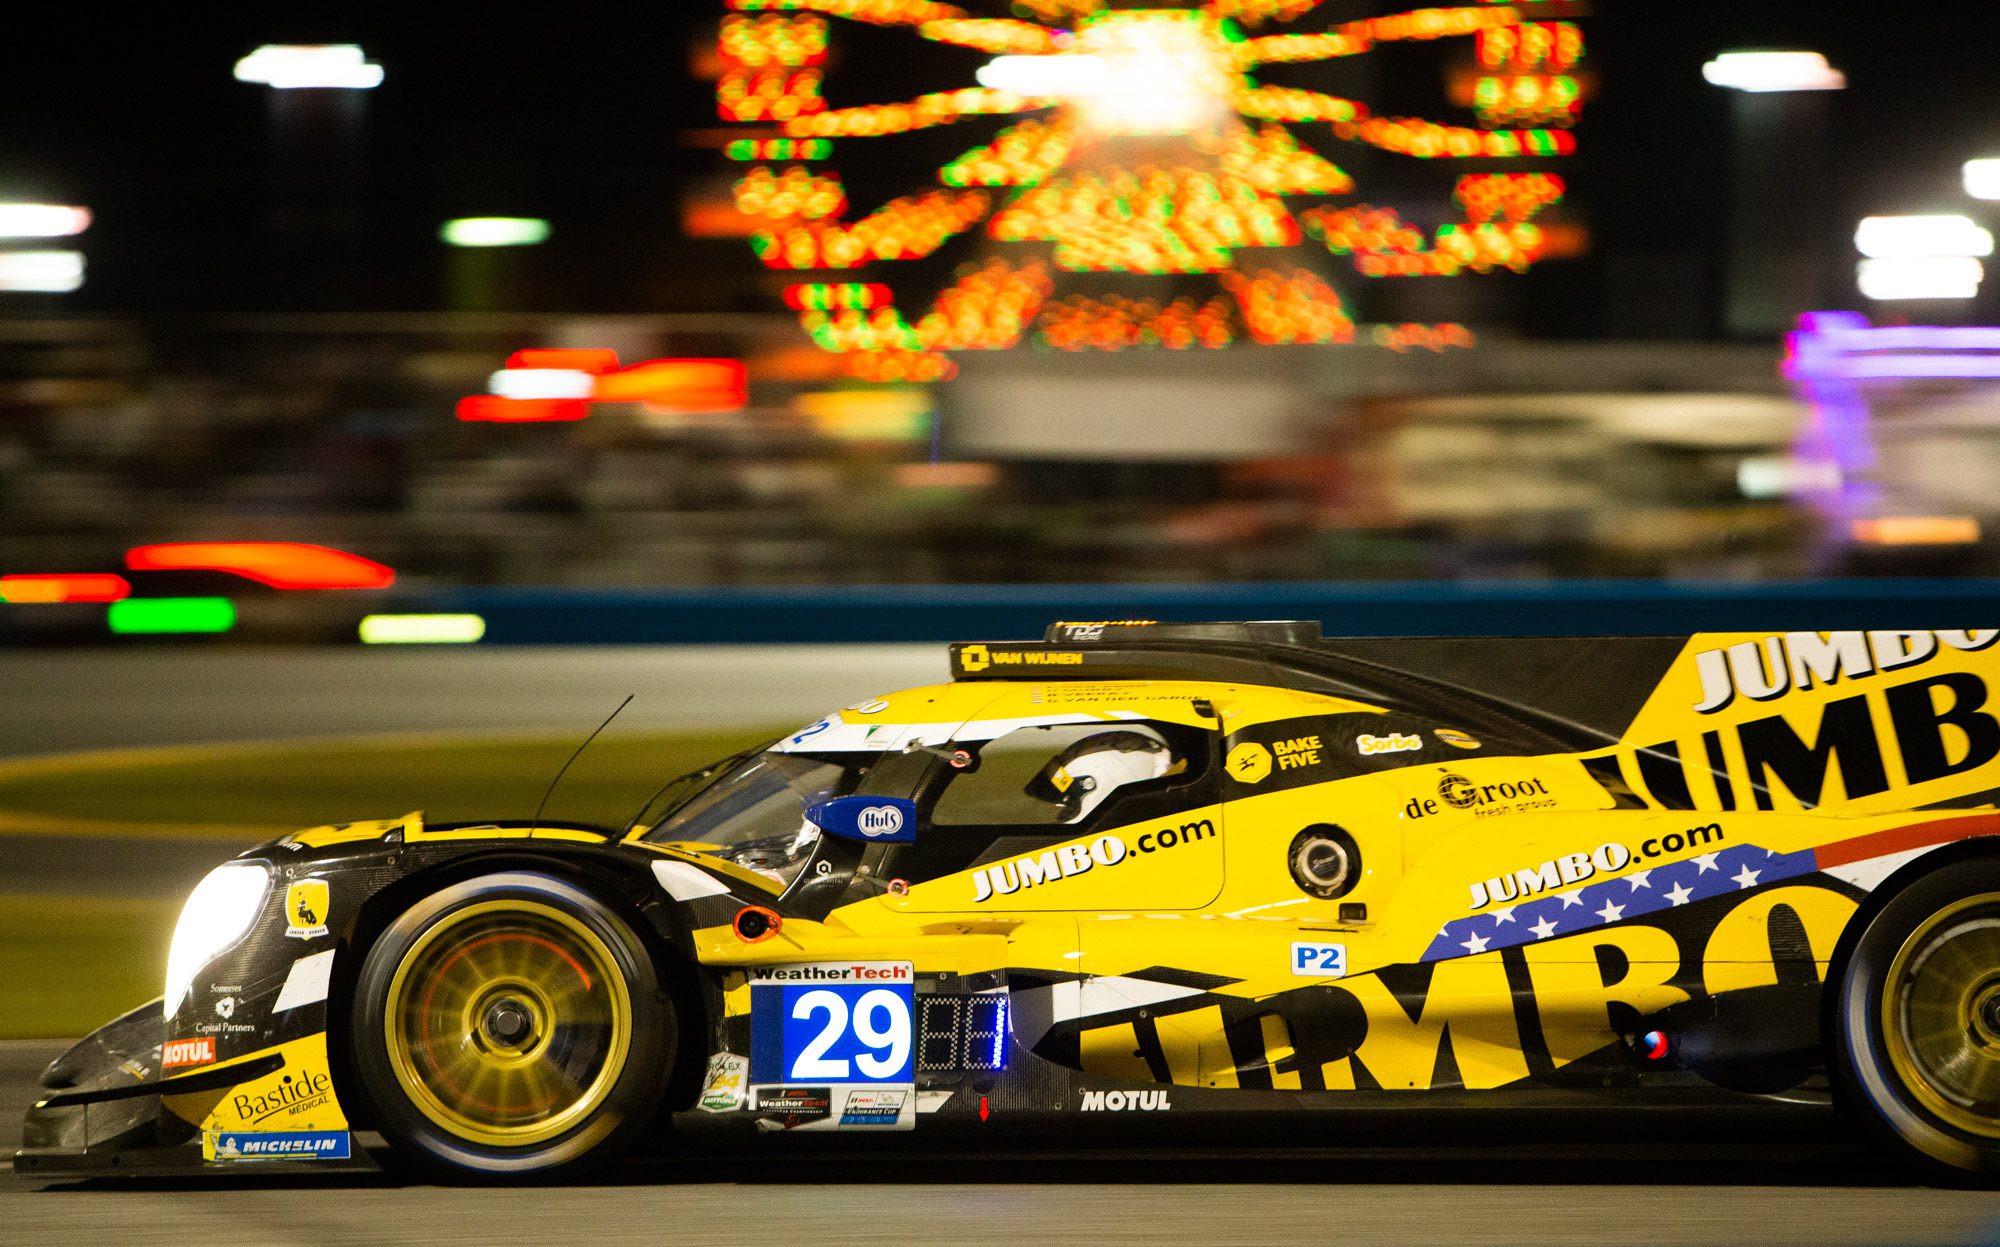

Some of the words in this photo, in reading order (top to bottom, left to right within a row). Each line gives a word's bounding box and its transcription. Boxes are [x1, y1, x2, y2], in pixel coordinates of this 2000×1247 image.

[1065, 625, 1105, 637] TDS
[991, 652, 1023, 664] VAN
[1273, 735, 1323, 755] BAKE
[1277, 750, 1321, 771] FIVE
[1406, 797, 1439, 820] de
[1440, 774, 1549, 809] Groot
[1475, 804, 1511, 818] fresh
[1515, 799, 1557, 813] group
[972, 819, 1216, 902] JUMBO.com
[1469, 822, 1724, 909] JUMBO.com
[1297, 946, 1340, 969] P2
[755, 965, 908, 980] WeatherTech
[210, 983, 242, 993] Somerset
[195, 1022, 221, 1035] Capital
[222, 1022, 255, 1032] Partners
[791, 989, 911, 1079] 29
[162, 1041, 213, 1065] MOTUL
[234, 1069, 330, 1120] Bastide
[1080, 1090, 1172, 1112] MOTUL
[243, 1138, 337, 1153] MICHELIN
